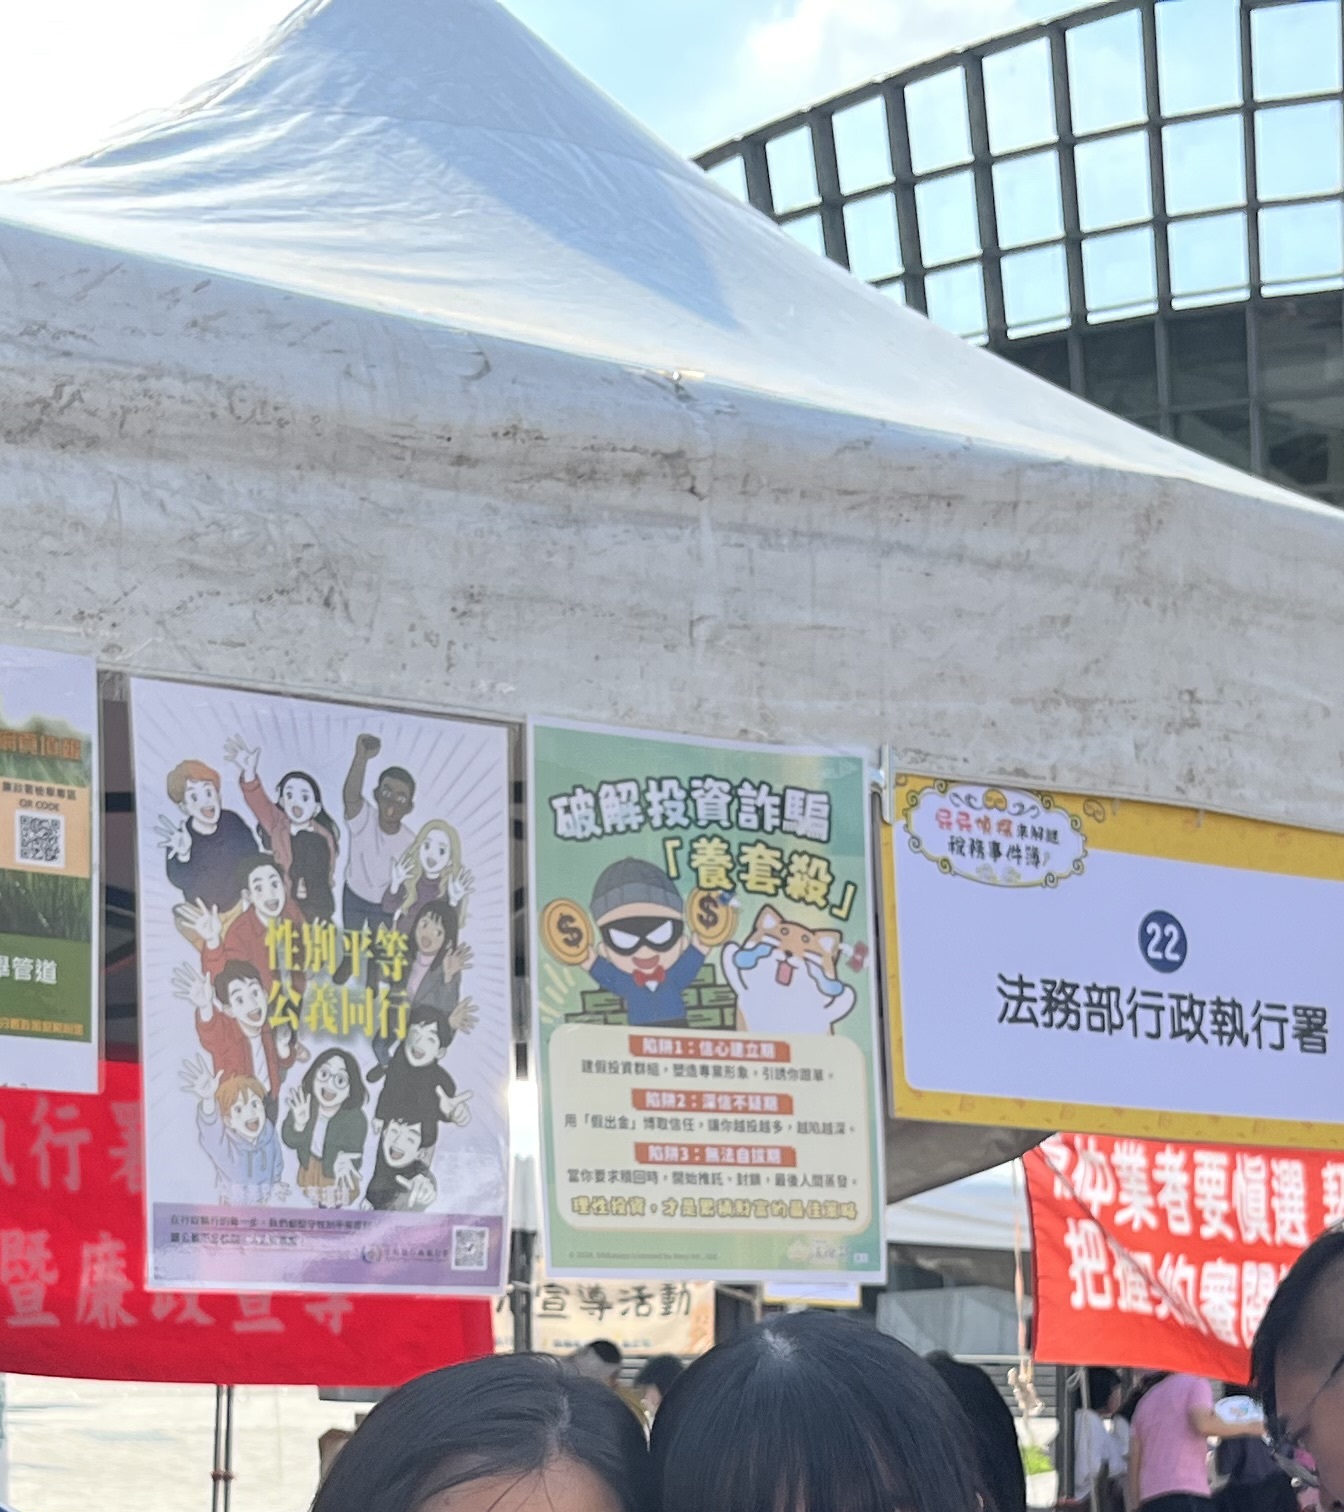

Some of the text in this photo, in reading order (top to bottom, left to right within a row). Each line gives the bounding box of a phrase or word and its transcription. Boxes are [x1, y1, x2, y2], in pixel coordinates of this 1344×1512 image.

[550, 775, 831, 844] 破解投資詐騙
[263, 916, 411, 981] 性別平等
[1145, 922, 1181, 963] 22
[267, 979, 411, 1040] 公義同行
[996, 972, 1328, 1056] 法務部行政執行署
[535, 1280, 692, 1322] 宣導活動
